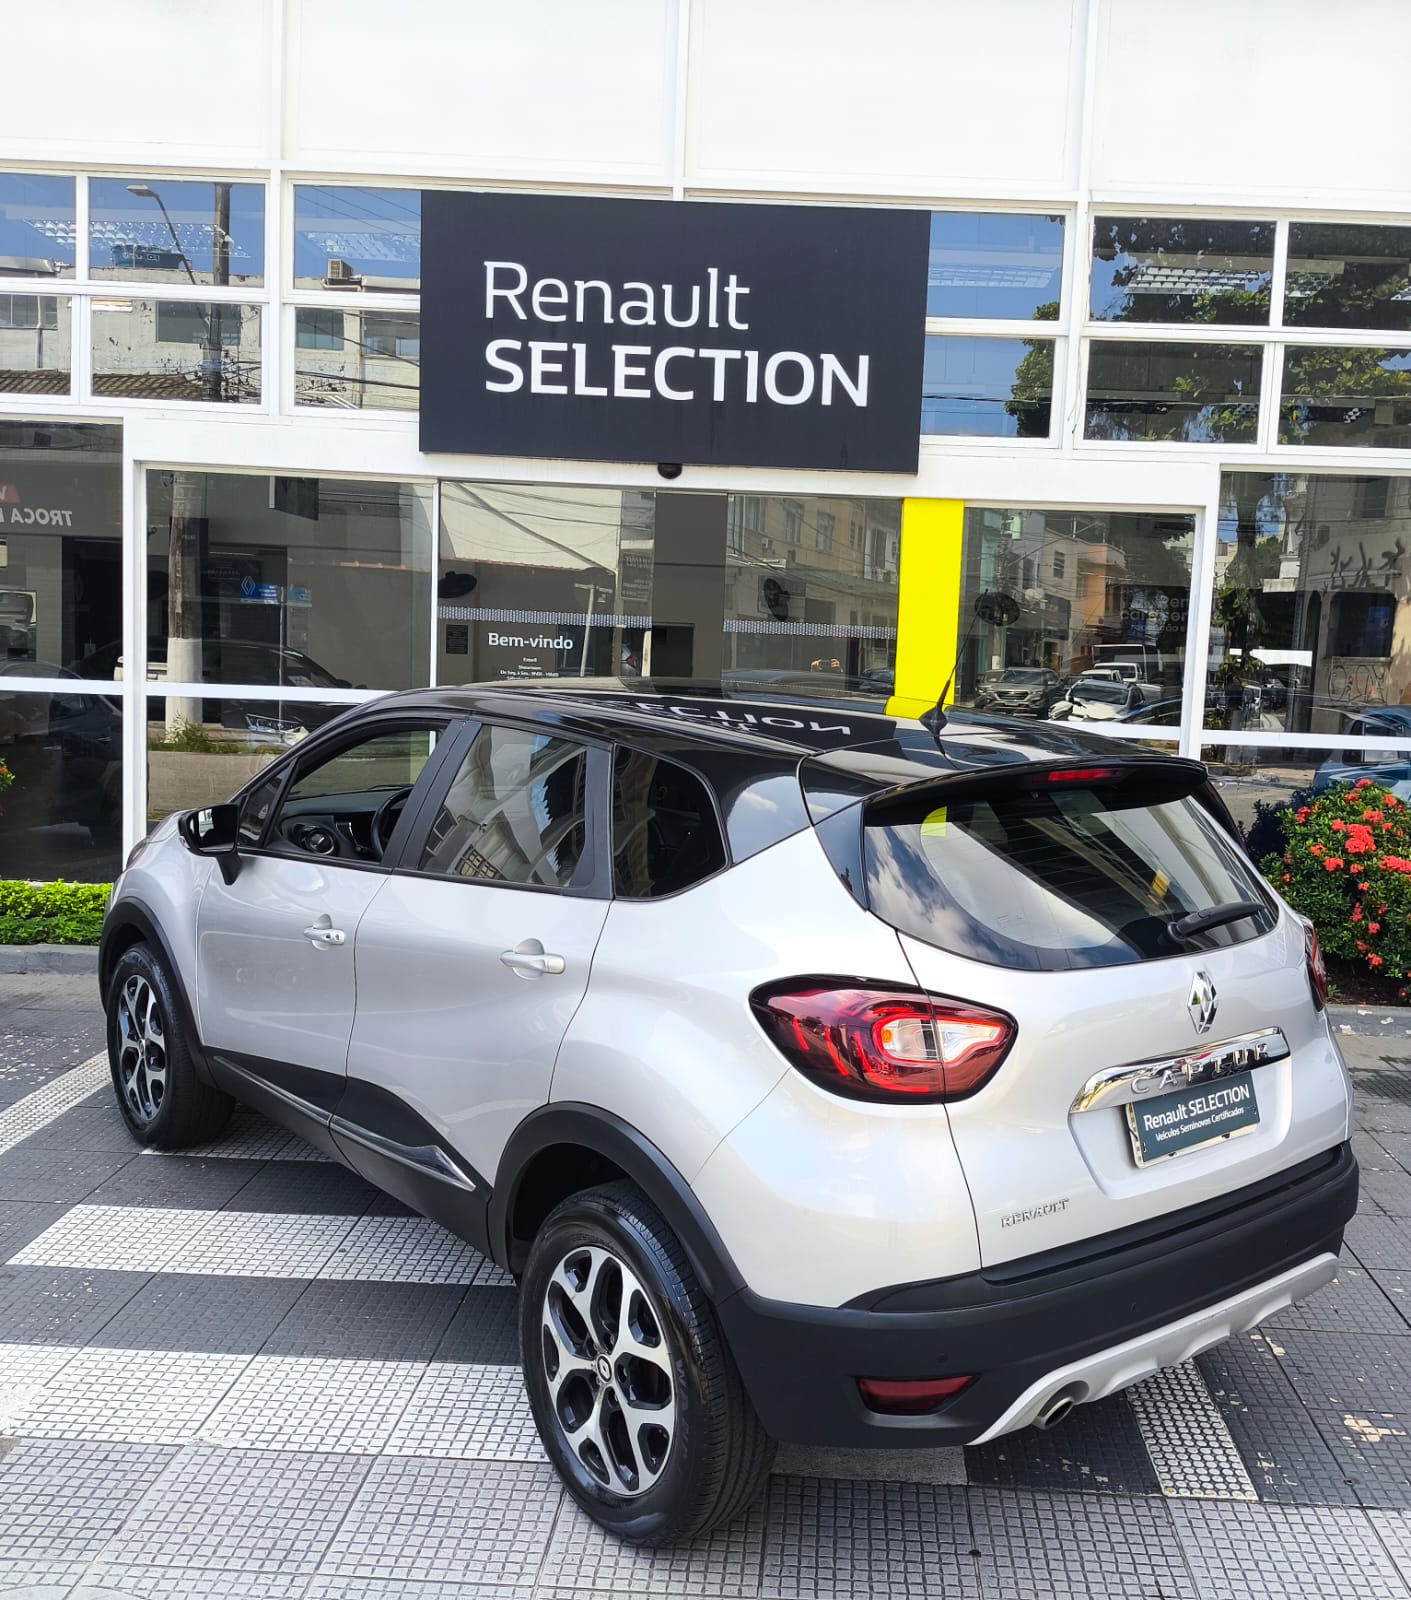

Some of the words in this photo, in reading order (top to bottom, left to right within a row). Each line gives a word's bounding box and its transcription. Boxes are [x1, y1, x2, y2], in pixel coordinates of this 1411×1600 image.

[484, 261, 750, 330] Renault
[485, 339, 869, 407] SELECTION
[488, 632, 574, 650] Bem-vindo
[1131, 1043, 1268, 1095] CAPTUR
[1143, 1103, 1188, 1131] Renault
[1188, 1083, 1250, 1116] SELECTION
[1155, 1126, 1180, 1142] Veículos
[1180, 1118, 1211, 1134] Seminovos
[1211, 1106, 1244, 1123] Certificados
[1001, 1198, 1070, 1228] RENAULT
